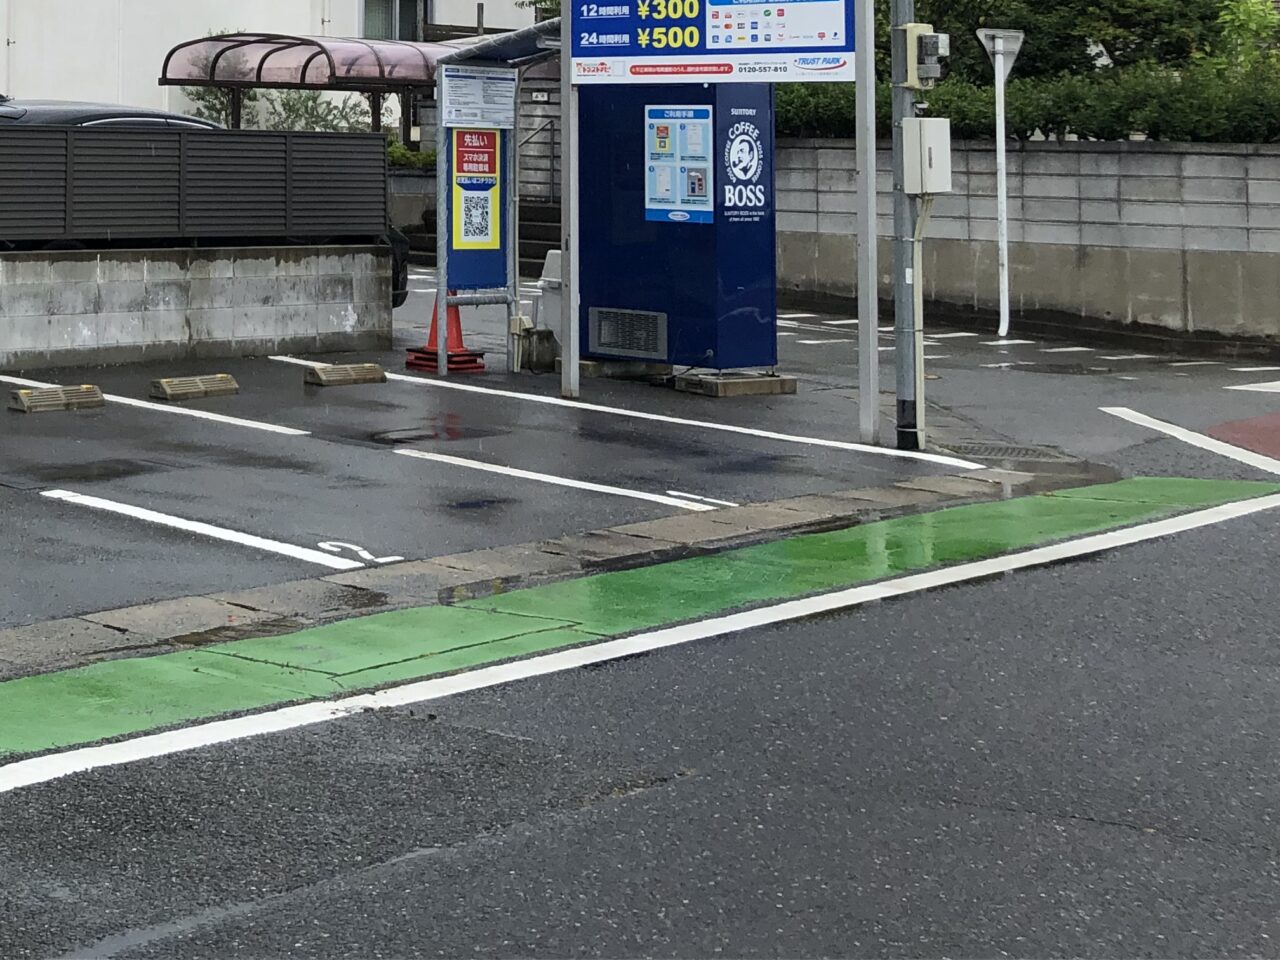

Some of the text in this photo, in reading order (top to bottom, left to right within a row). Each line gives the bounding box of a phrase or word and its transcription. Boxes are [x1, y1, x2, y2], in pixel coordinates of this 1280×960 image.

[637, 25, 700, 49] ¥500
[822, 57, 842, 65] PARK
[730, 108, 757, 116] SUNTORY
[463, 133, 488, 146] 先払い
[728, 122, 760, 140] COFFEE
[724, 185, 765, 207] BOSS
[317, 541, 405, 563] 2
